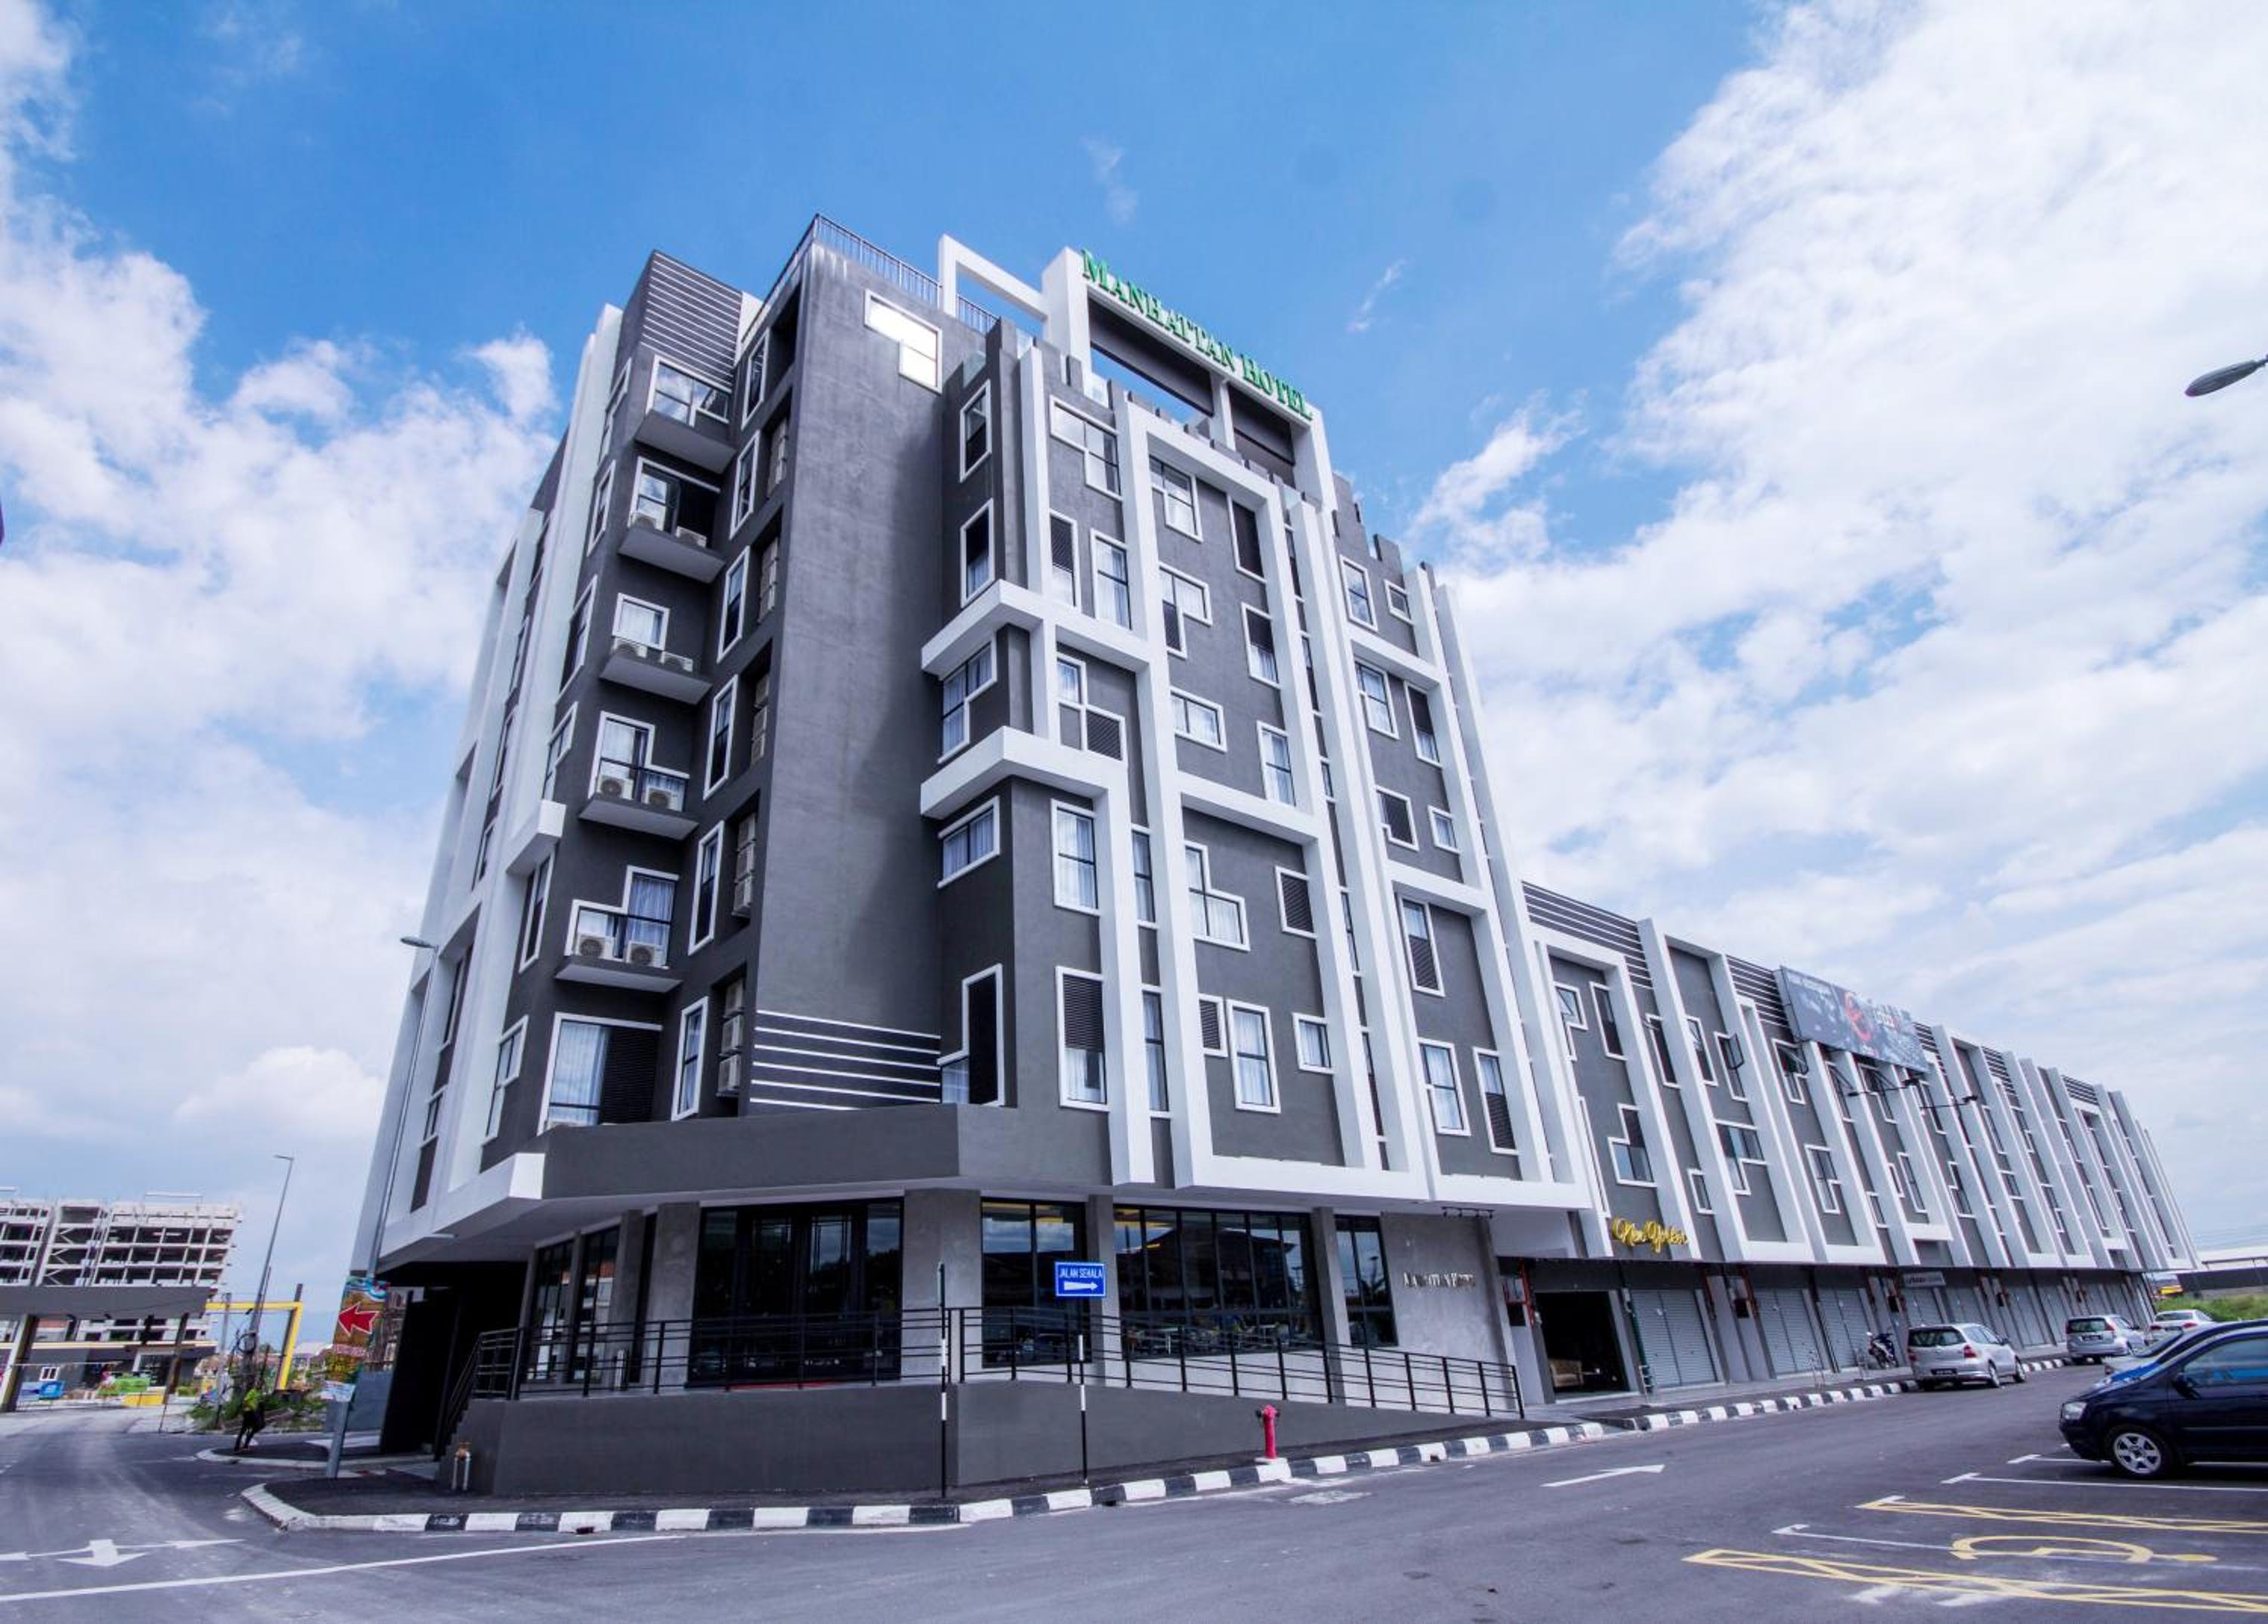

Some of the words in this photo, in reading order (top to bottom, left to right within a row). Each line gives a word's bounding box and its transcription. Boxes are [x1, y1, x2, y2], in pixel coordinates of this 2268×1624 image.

[1082, 249, 1235, 371] MANHATTAN
[1241, 353, 1314, 420] HOTEL
[1059, 1267, 1079, 1278] JALAN
